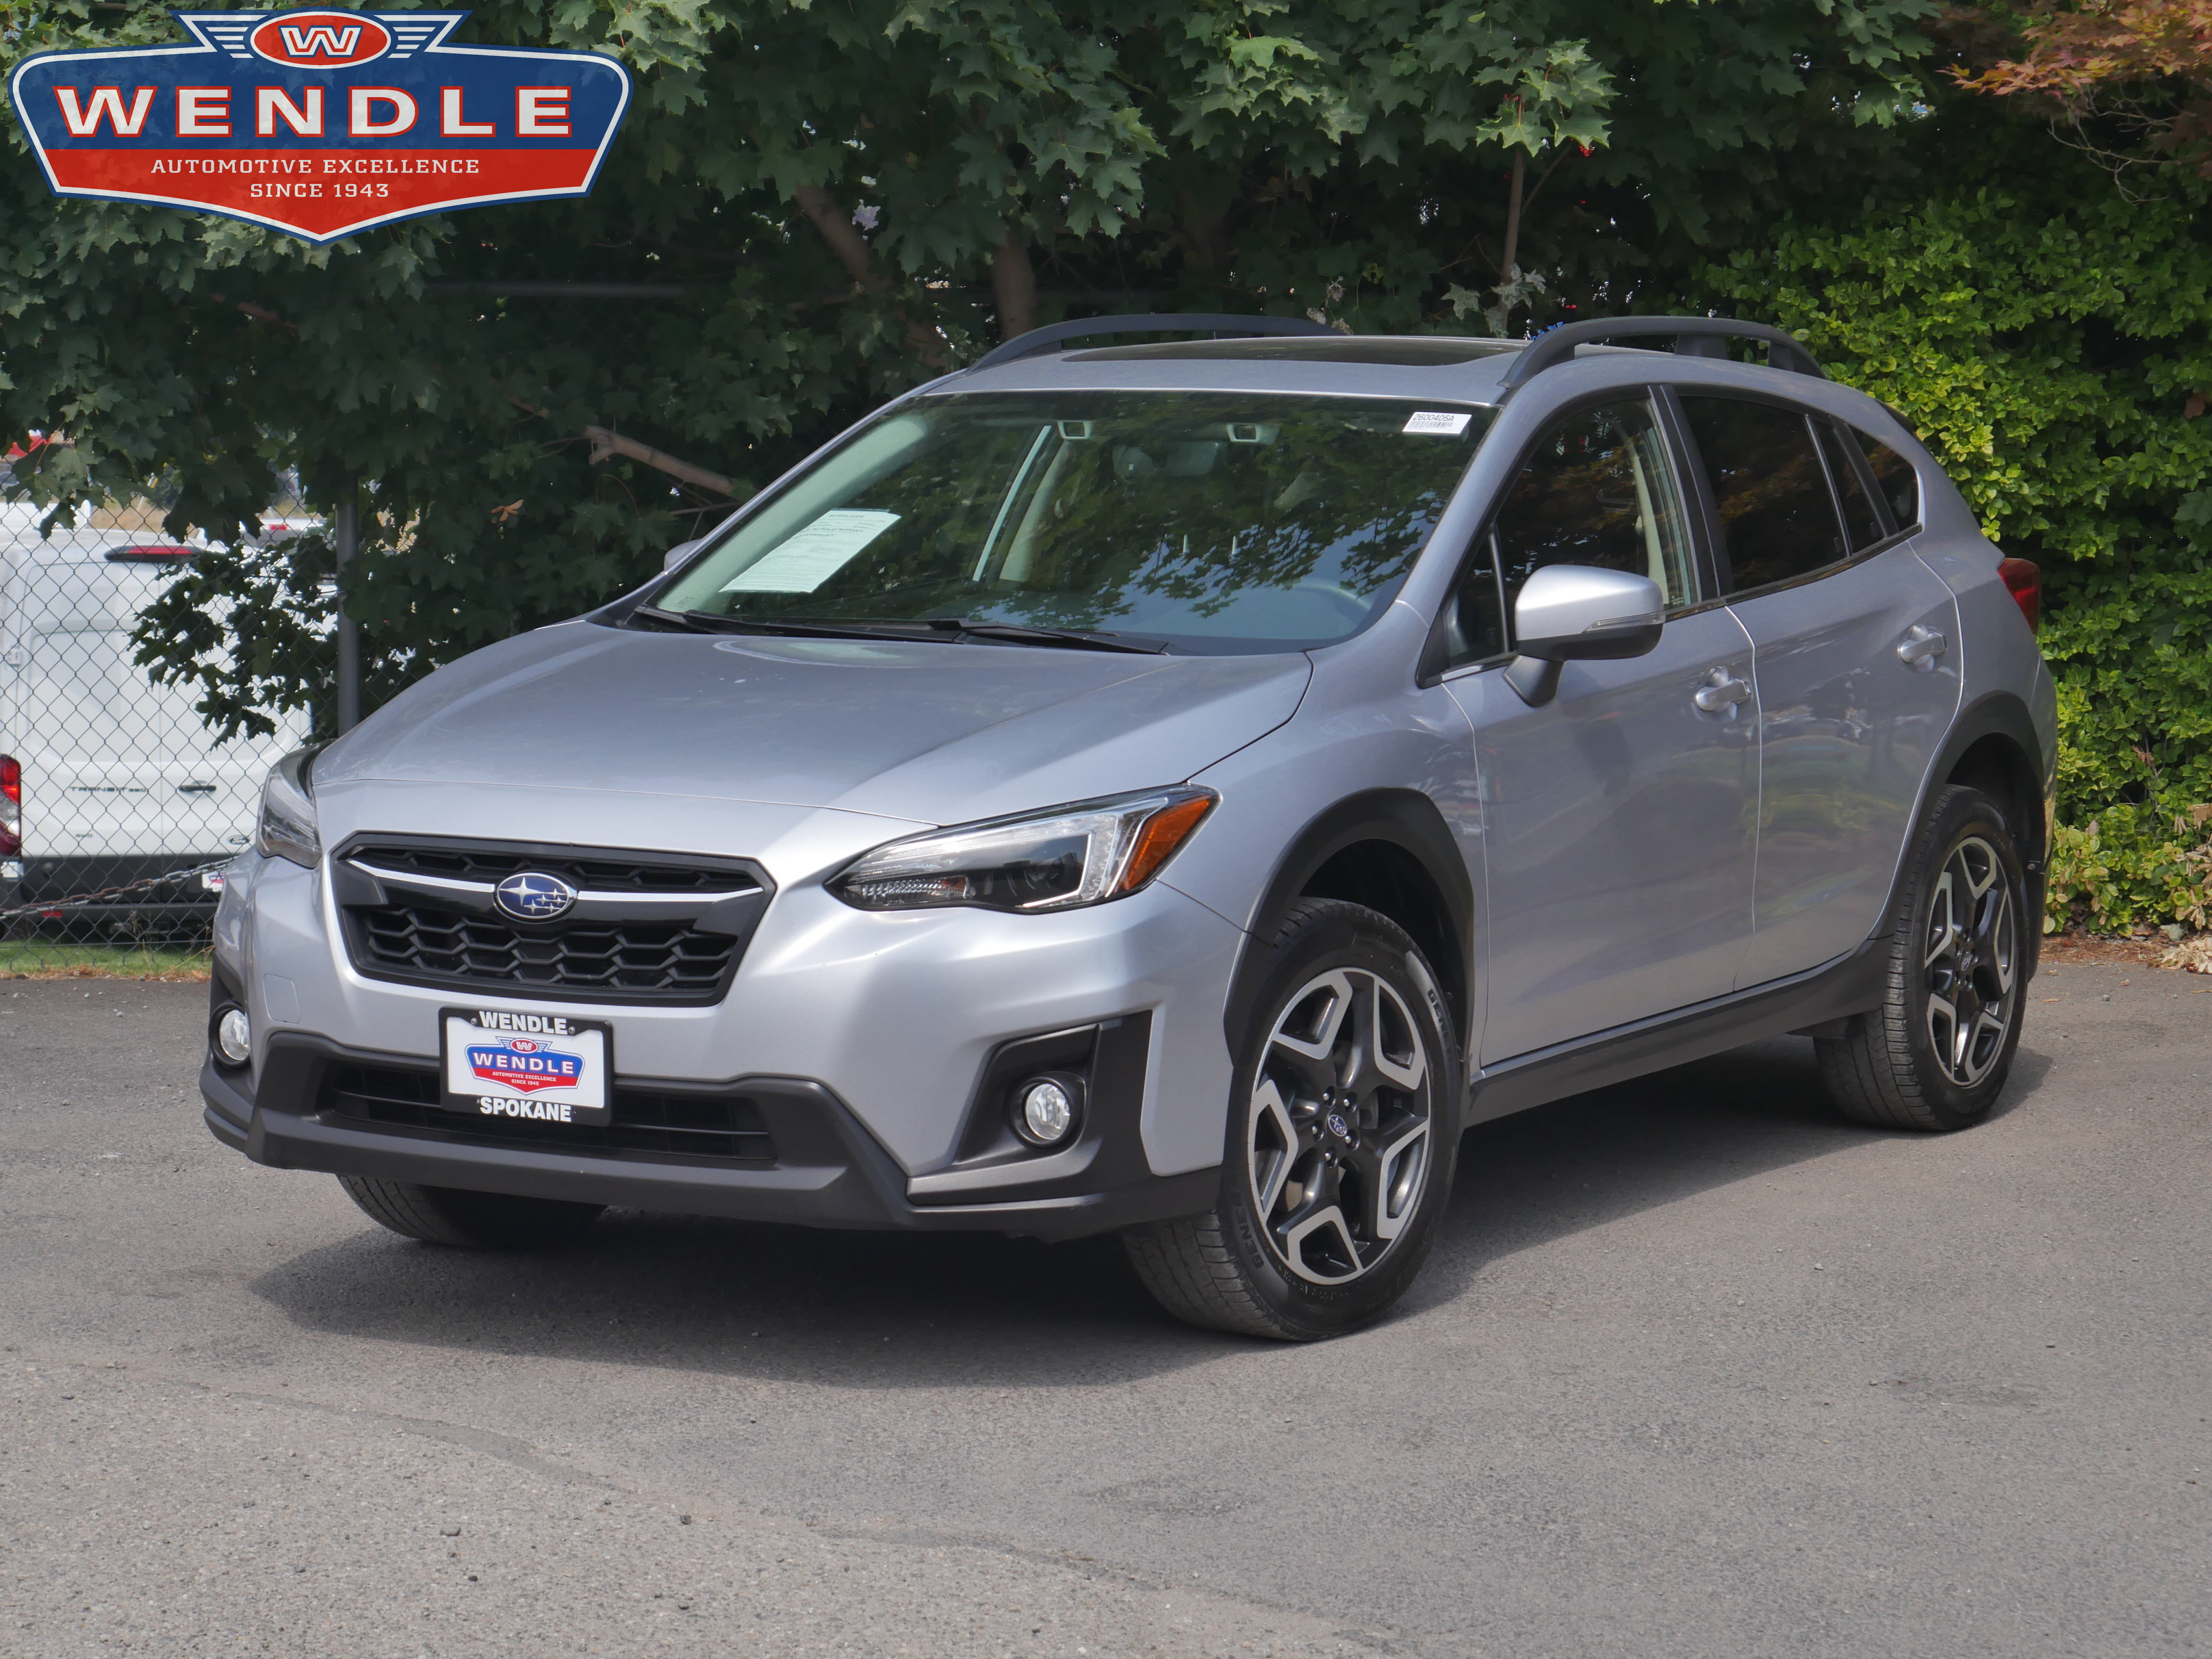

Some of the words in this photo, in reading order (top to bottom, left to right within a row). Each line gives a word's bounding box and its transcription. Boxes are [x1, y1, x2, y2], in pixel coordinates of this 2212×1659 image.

[1413, 413, 1454, 422] 2600405A
[480, 1011, 567, 1035] WENDLE
[474, 1053, 574, 1074] WENDLE
[480, 1097, 571, 1122] SPOKANE
